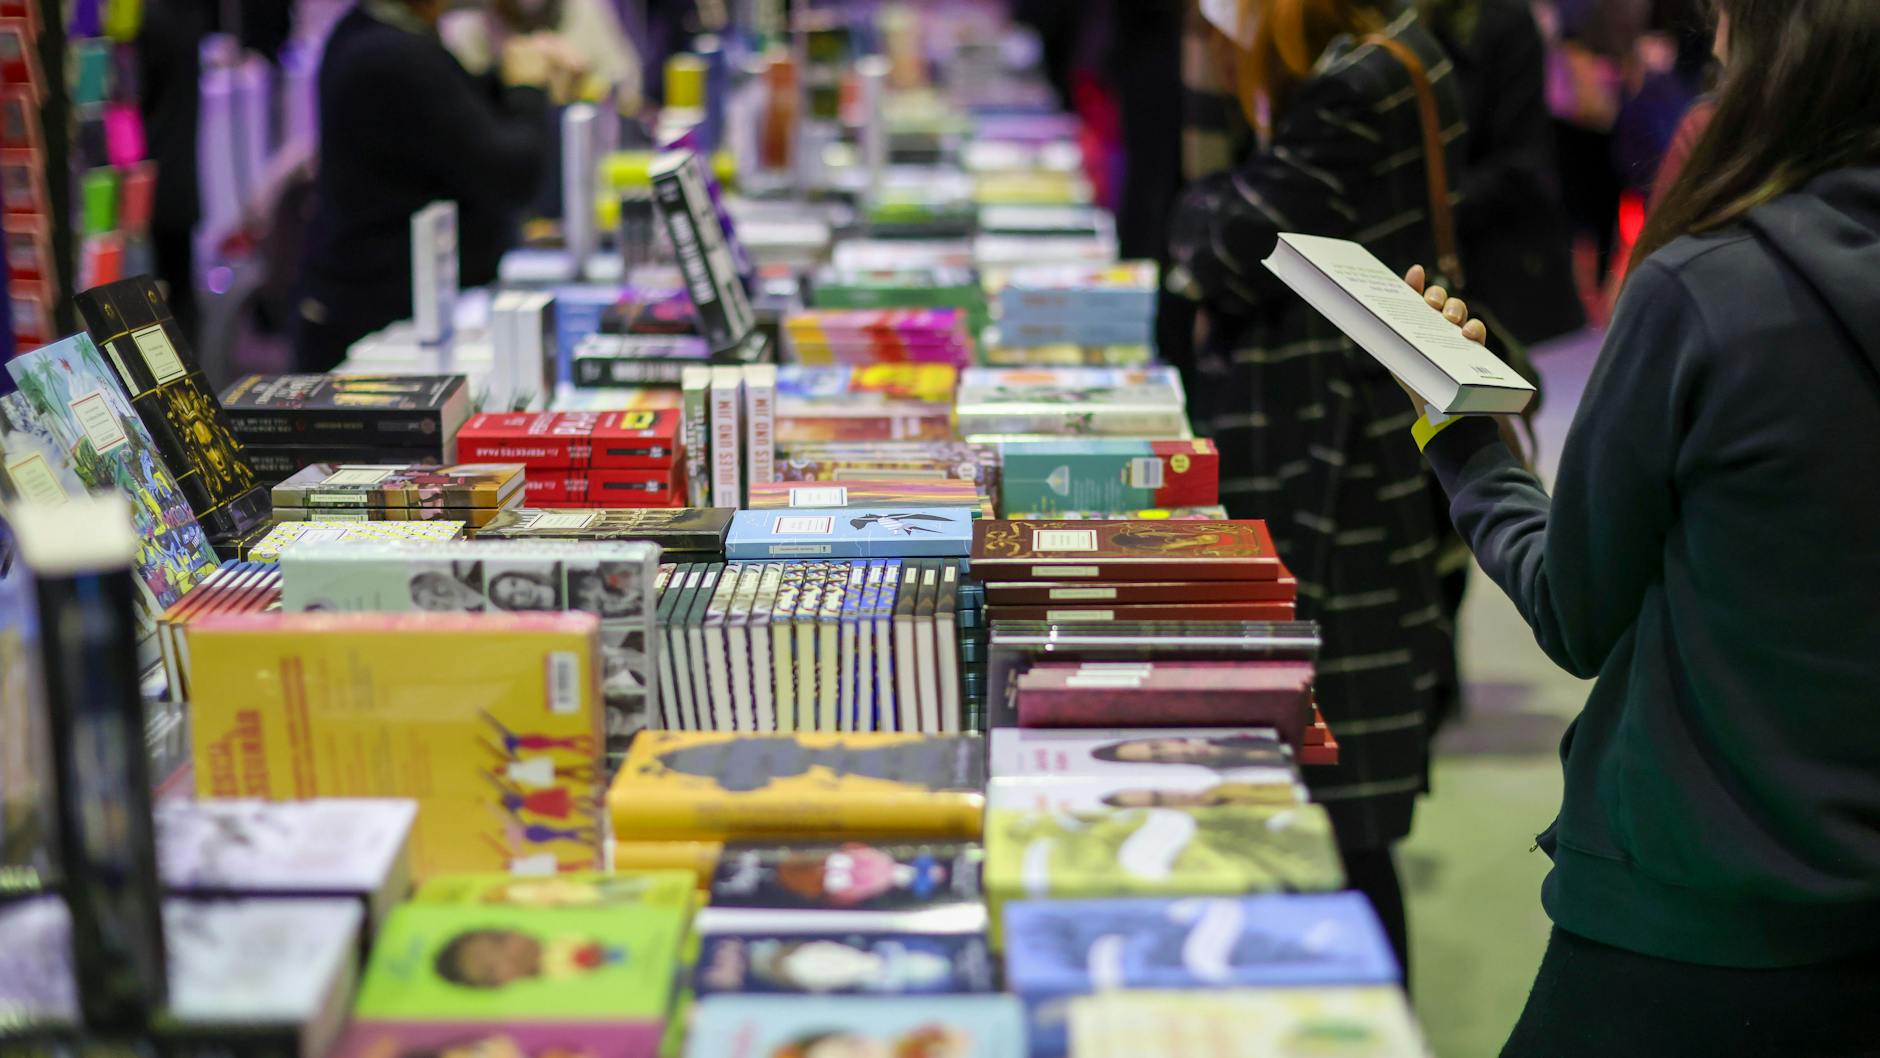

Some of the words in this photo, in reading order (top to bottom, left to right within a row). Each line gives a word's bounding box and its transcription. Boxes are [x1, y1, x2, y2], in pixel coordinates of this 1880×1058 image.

[718, 400, 733, 419] JIM
[755, 399, 769, 417] JIM
[719, 424, 733, 448] UND
[755, 422, 769, 446] UND
[476, 448, 499, 457] PAAR
[719, 452, 735, 485] JULES
